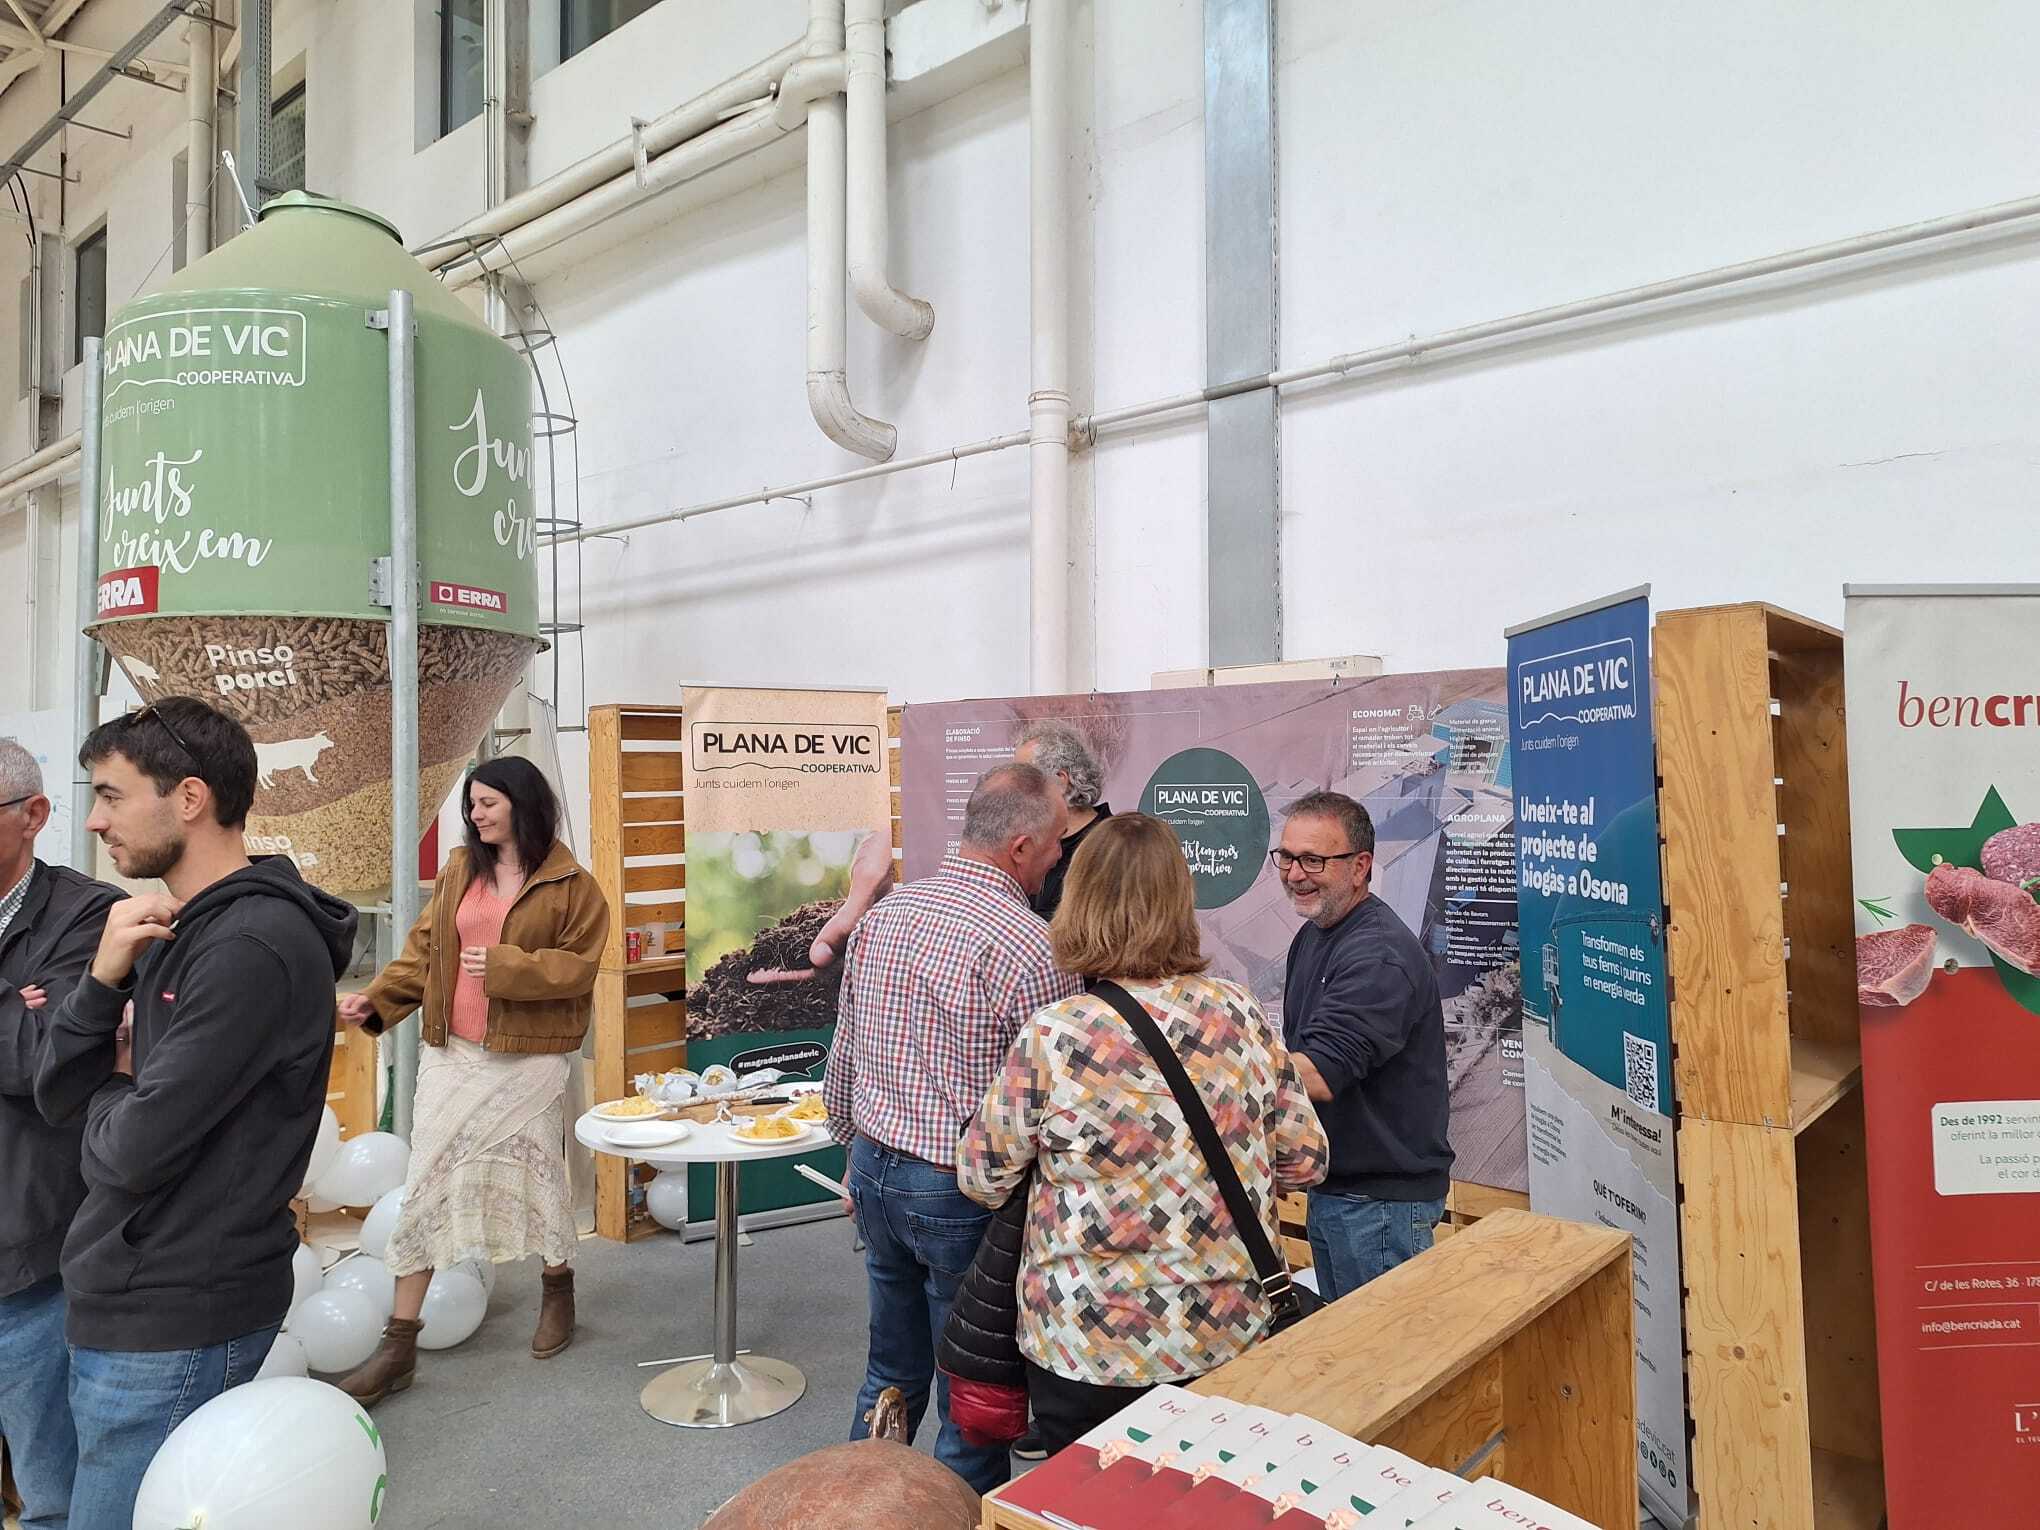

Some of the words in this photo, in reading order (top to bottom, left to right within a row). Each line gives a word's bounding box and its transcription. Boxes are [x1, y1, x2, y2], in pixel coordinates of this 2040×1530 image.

[169, 325, 211, 358] DE
[222, 325, 289, 358] VIC
[177, 371, 294, 386] COOPERATIVA
[103, 449, 202, 543] Junts
[113, 528, 272, 574] creixem
[457, 588, 502, 609] ERRA
[204, 644, 293, 668] Pinso
[1523, 668, 1571, 704] PLANA
[1573, 663, 1595, 696] DE
[1598, 656, 1629, 692] VIC
[1352, 708, 1402, 719] ECONOMAT
[1578, 703, 1633, 724] COOPERATIVA
[703, 733, 788, 754] PLANA
[794, 734, 825, 754] DE
[831, 735, 871, 755] VIC
[1535, 735, 1557, 750] cuidem
[801, 763, 875, 774] COOPERATIVA
[694, 778, 721, 789] Junts
[723, 778, 762, 789] cuidem
[764, 778, 800, 791] l'origen
[1158, 790, 1199, 804] PLANA
[1201, 790, 1219, 804] DE
[1222, 790, 1244, 804] VIC
[1205, 809, 1246, 817] COOPERATIVA
[1447, 814, 1507, 823] AGROPLANA
[1520, 795, 1577, 825] Uneix-te
[1580, 796, 1595, 825] al
[1521, 829, 1576, 860] projecte
[1578, 833, 1597, 862] de
[1522, 861, 1565, 897] biogàs
[1567, 875, 1577, 896] a
[1579, 868, 1628, 906] Osona
[1580, 930, 1629, 958] Transformem
[1629, 944, 1645, 962] els
[1582, 953, 1598, 970] teus
[1599, 955, 1620, 976] fems
[1623, 965, 1652, 986] purins
[1583, 975, 1592, 988] en
[1592, 976, 1622, 999] energia
[1622, 986, 1645, 1006] verda
[1611, 1104, 1662, 1143] M'interessa!
[1940, 1116, 1960, 1127] Des
[1961, 1115, 1975, 1126] de
[1977, 1114, 2002, 1125] 1992
[1951, 1130, 1986, 1141] oferint
[1989, 1129, 1998, 1140] la
[2001, 1128, 2034, 1140] millor
[1980, 1154, 1992, 1165] La
[1995, 1153, 2030, 1166] passió
[1998, 1169, 2008, 1179] el
[2011, 1170, 2029, 1179] cor
[1924, 1281, 1938, 1292] C/
[1940, 1280, 1954, 1291] de
[1955, 1279, 1970, 1290] les
[1971, 1278, 2004, 1290] Rotes,
[2005, 1277, 2020, 1288] 36
[1921, 1319, 2022, 1334] info@bencriada.cat
